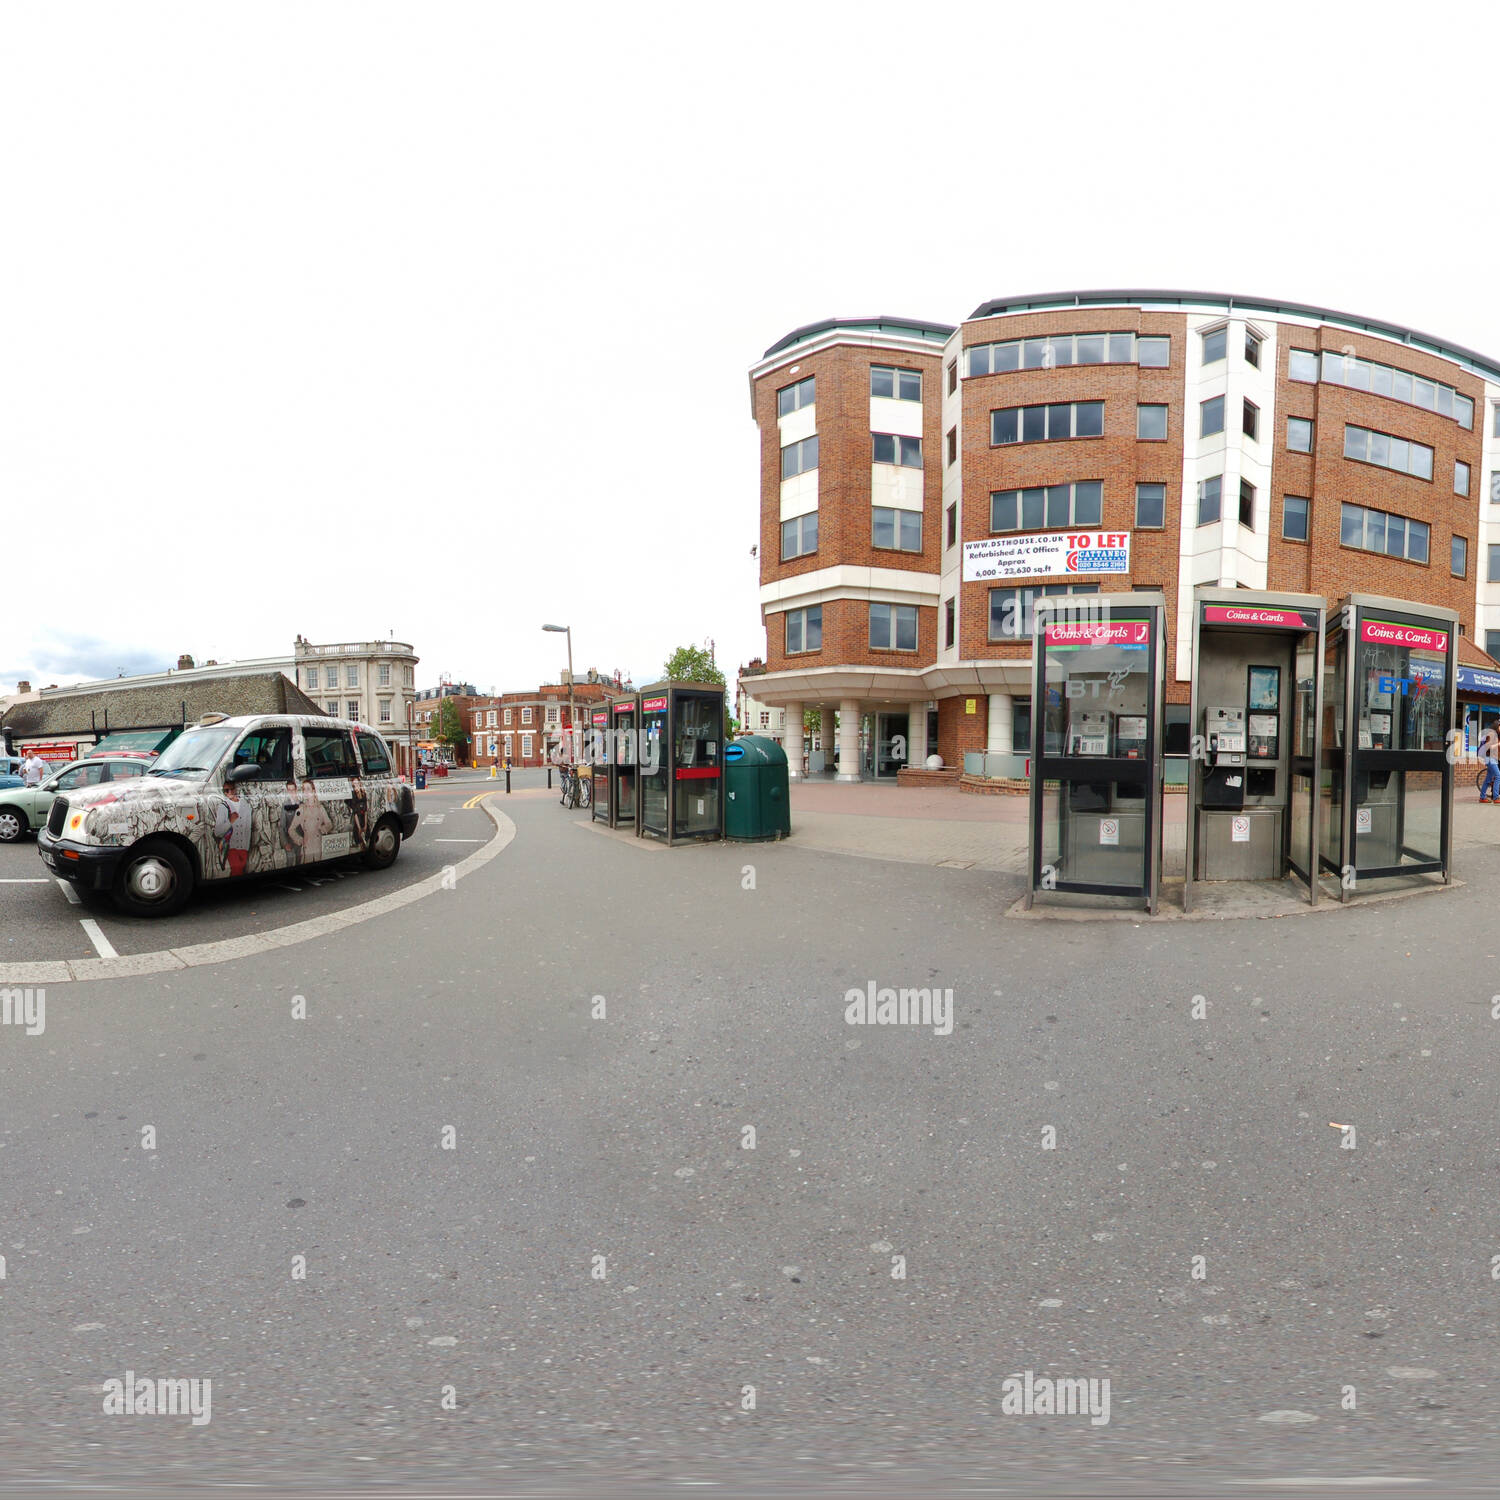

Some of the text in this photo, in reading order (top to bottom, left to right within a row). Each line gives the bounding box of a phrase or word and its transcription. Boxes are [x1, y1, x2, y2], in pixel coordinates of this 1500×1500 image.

[966, 536, 1063, 550] WWW.DSTHOUSE.CO.UK
[1067, 534, 1127, 548] TO LET
[970, 549, 1014, 559] Refurbished
[1033, 546, 1059, 554] Offices
[976, 569, 996, 578] 6,000
[1004, 567, 1031, 575] 23,630
[1034, 565, 1051, 573] sq.ft
[1226, 610, 1250, 620] Coins
[1260, 612, 1284, 622] Cards
[1052, 626, 1128, 640] Coins & Cards
[1367, 626, 1431, 644] Coins & Cards
[1066, 680, 1106, 698] BT
[1378, 676, 1414, 696] BT
